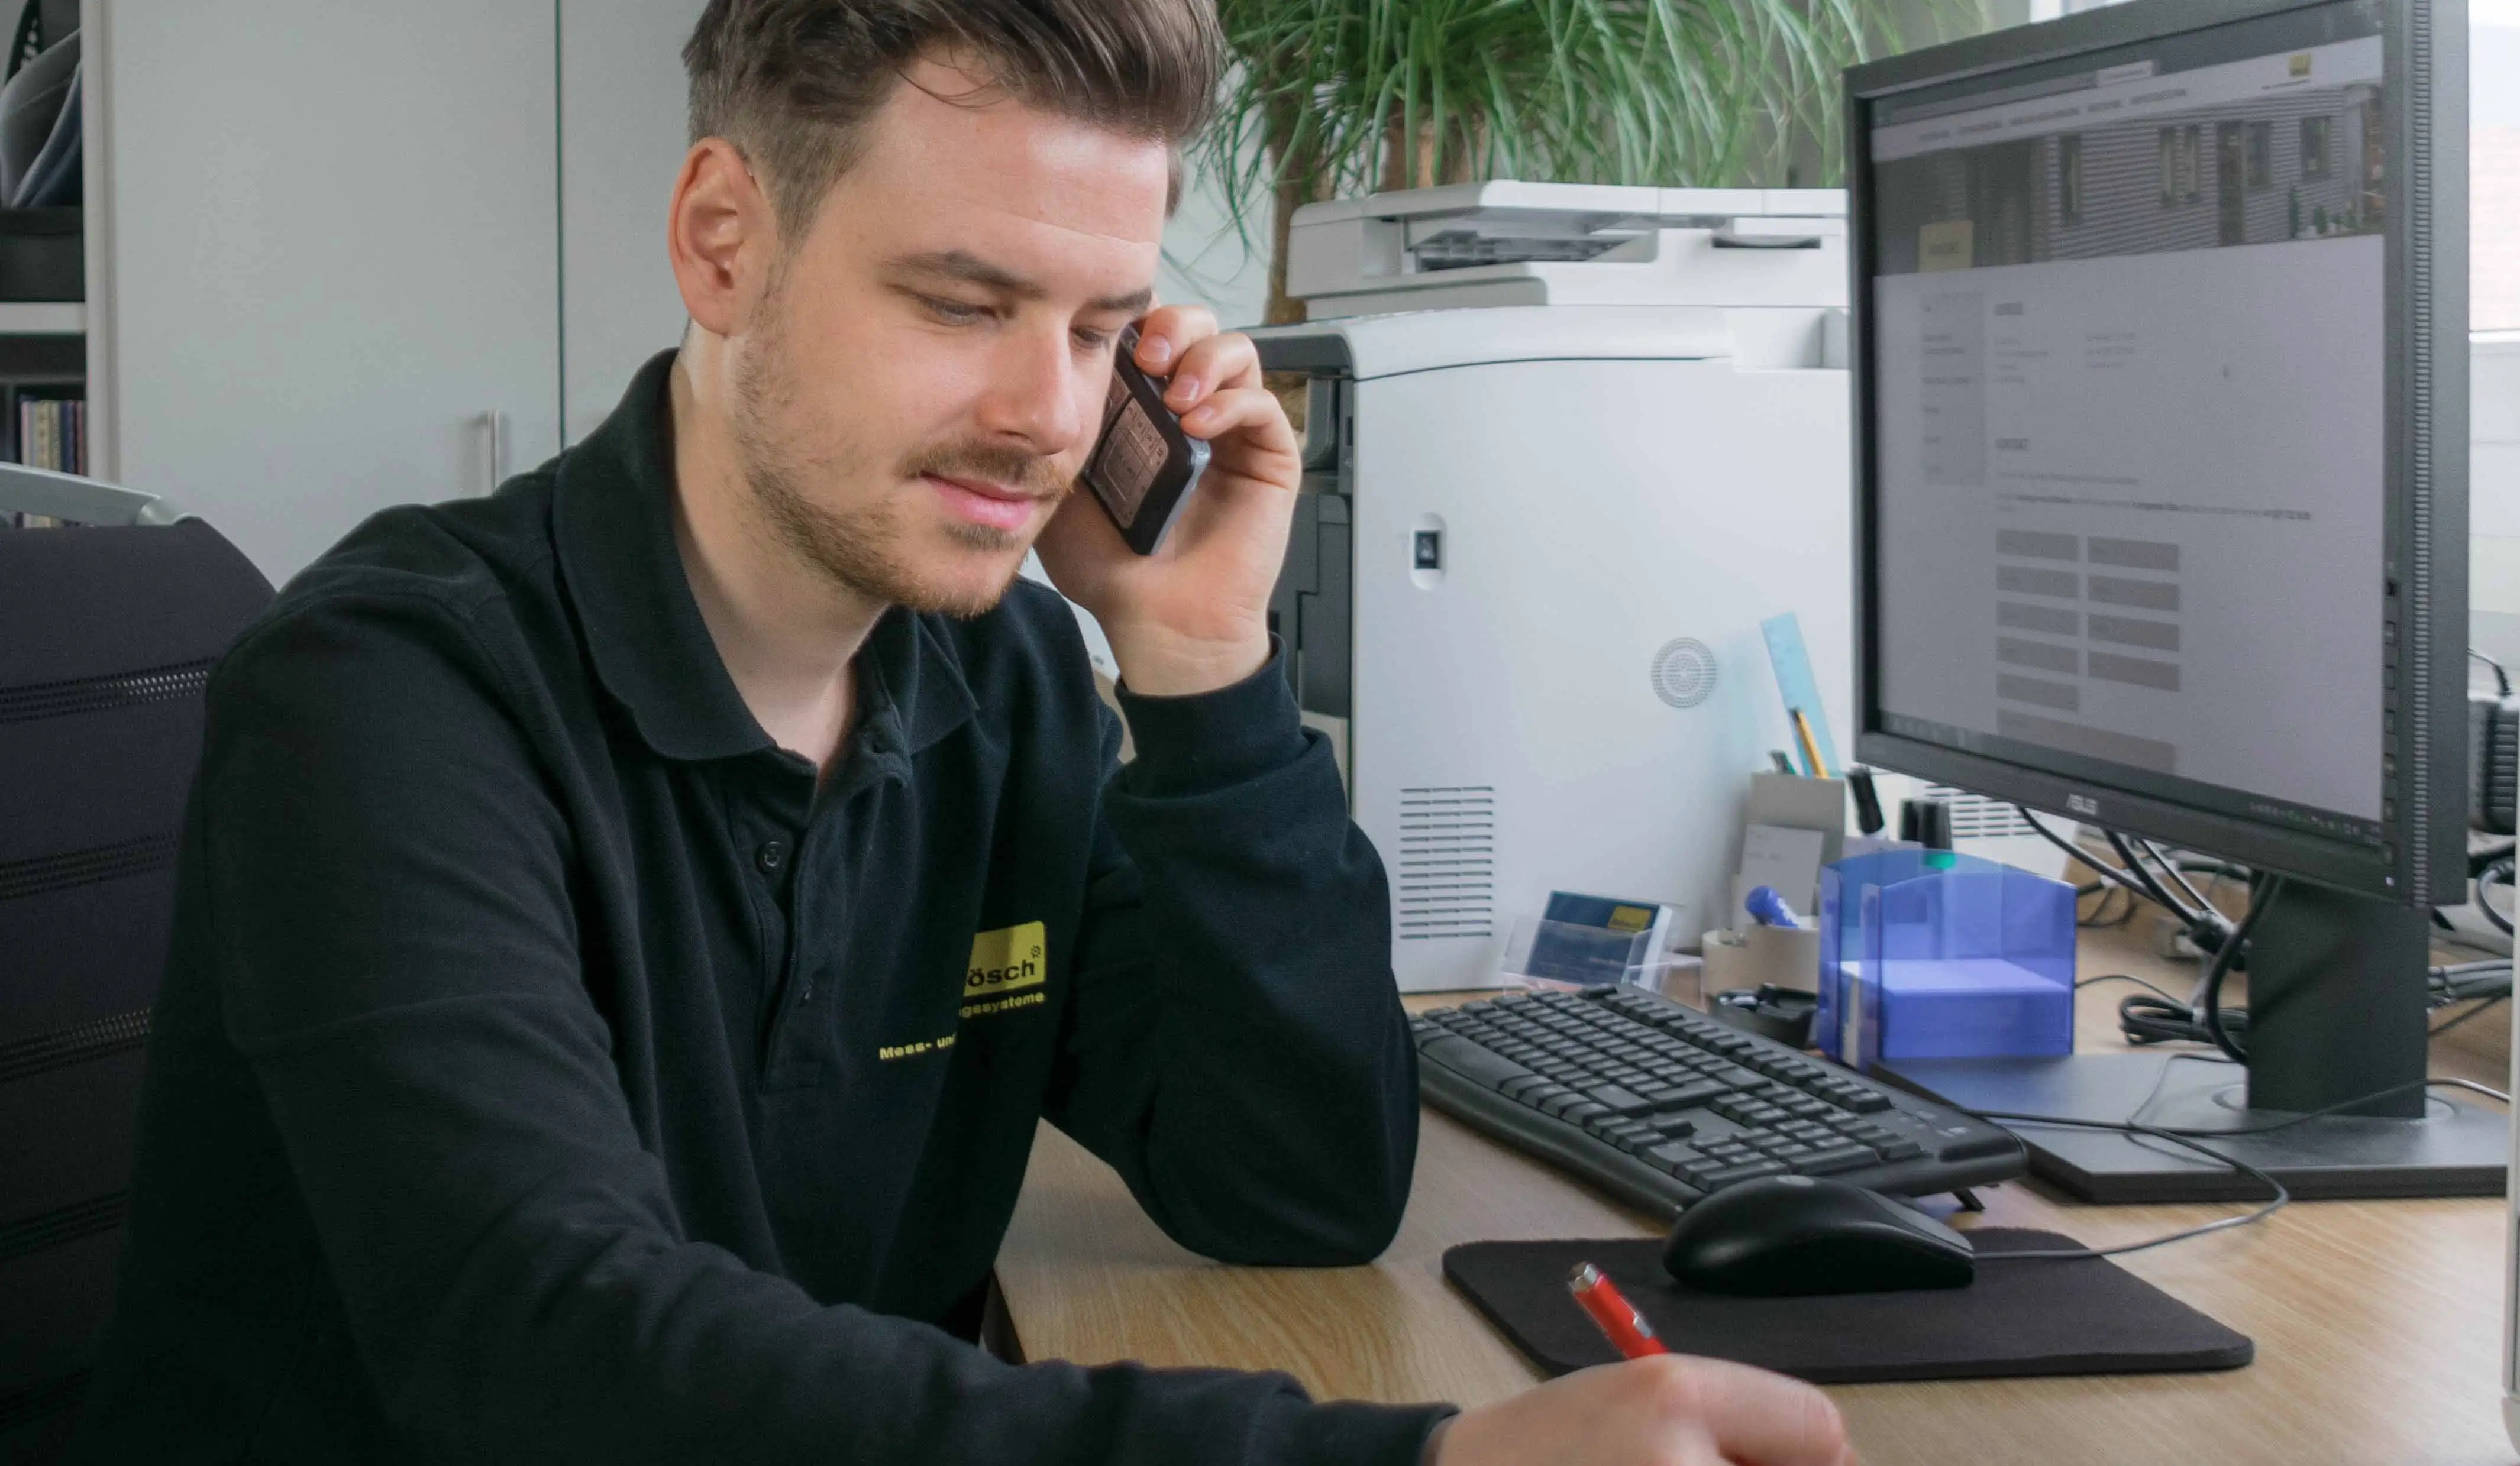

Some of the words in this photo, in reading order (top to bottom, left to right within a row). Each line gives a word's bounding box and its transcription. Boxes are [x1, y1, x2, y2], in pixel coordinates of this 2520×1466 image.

[2066, 793, 2099, 817] ASUS
[967, 959, 1035, 988] ösch
[936, 1031, 957, 1049] un
[959, 991, 1045, 1018] gssysteme
